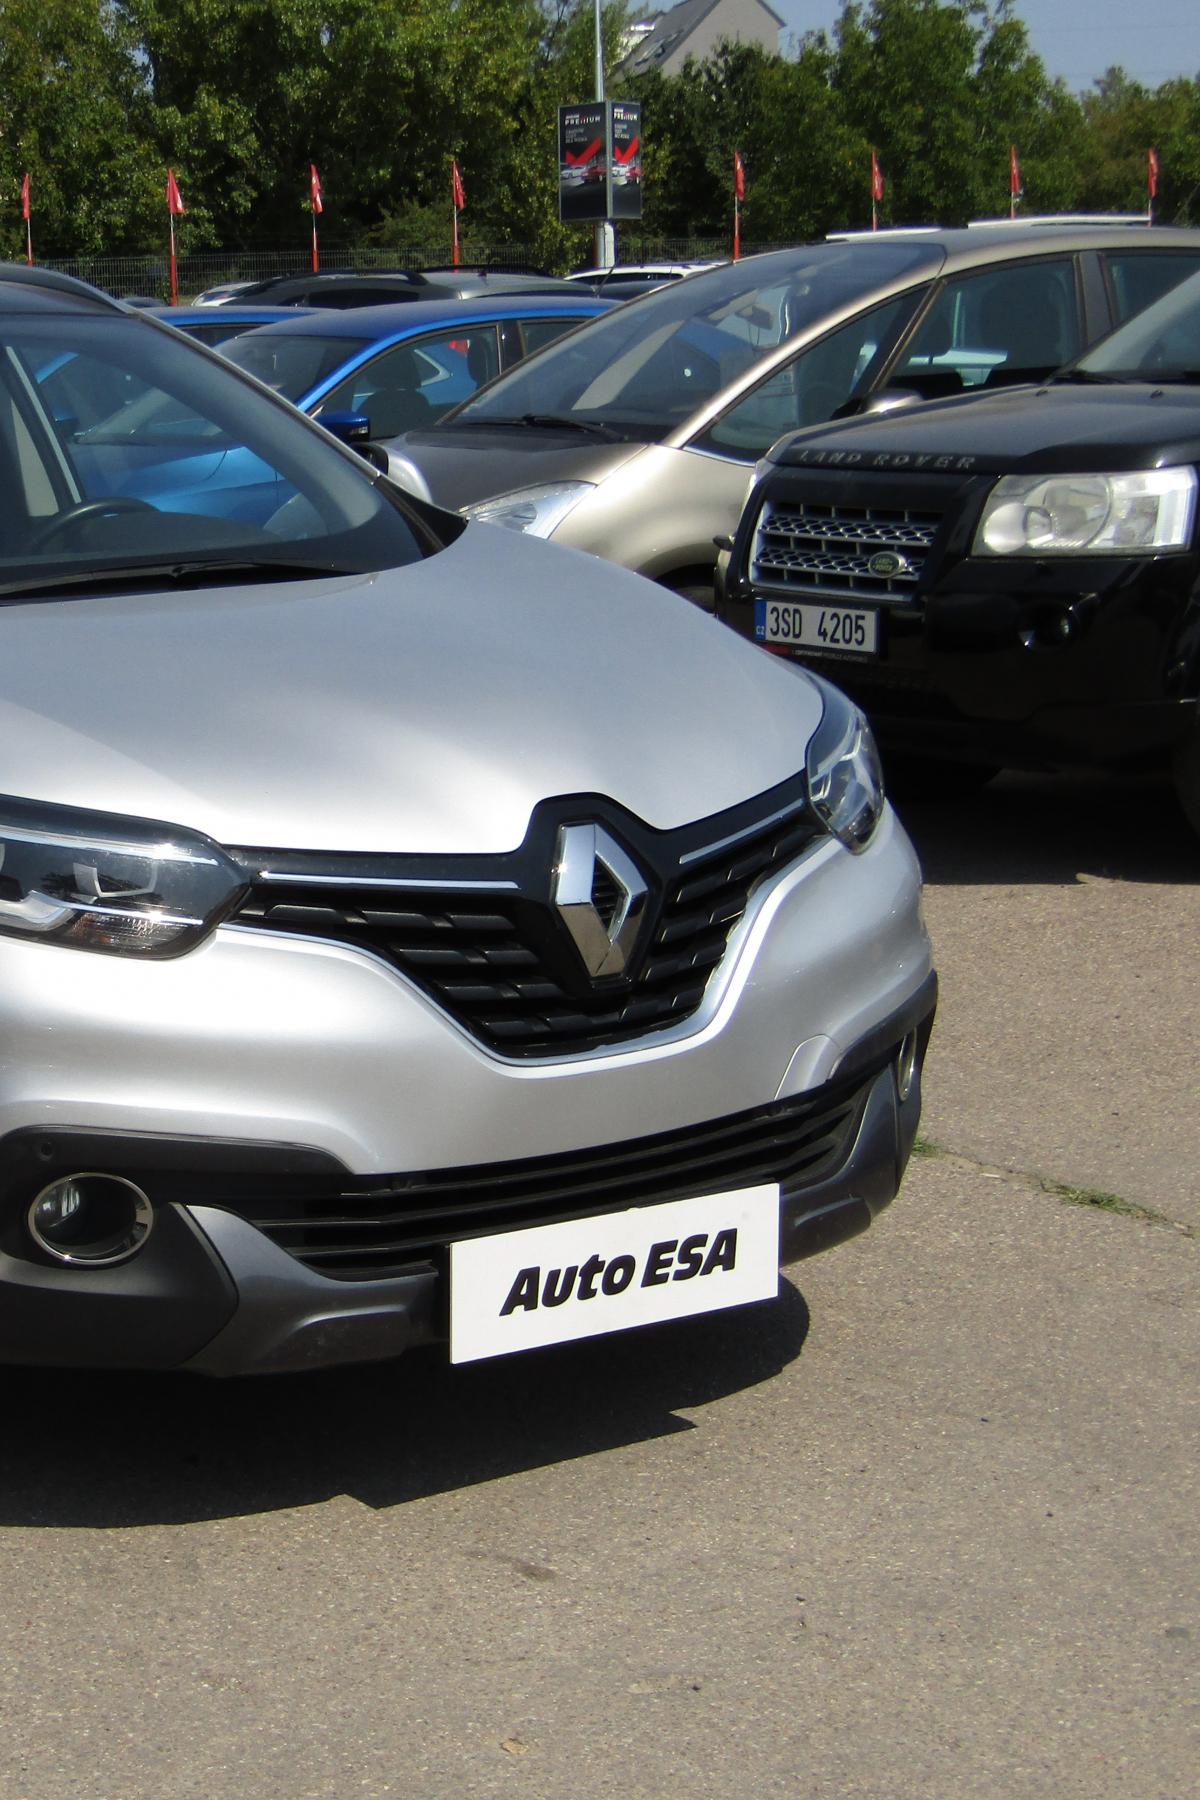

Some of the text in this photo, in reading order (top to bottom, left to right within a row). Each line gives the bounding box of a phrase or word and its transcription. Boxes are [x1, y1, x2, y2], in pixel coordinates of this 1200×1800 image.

[800, 450, 976, 469] LAND ROVER
[769, 606, 803, 638] 3SD
[817, 611, 866, 646] 4205
[499, 1227, 738, 1317] Auto ESA
